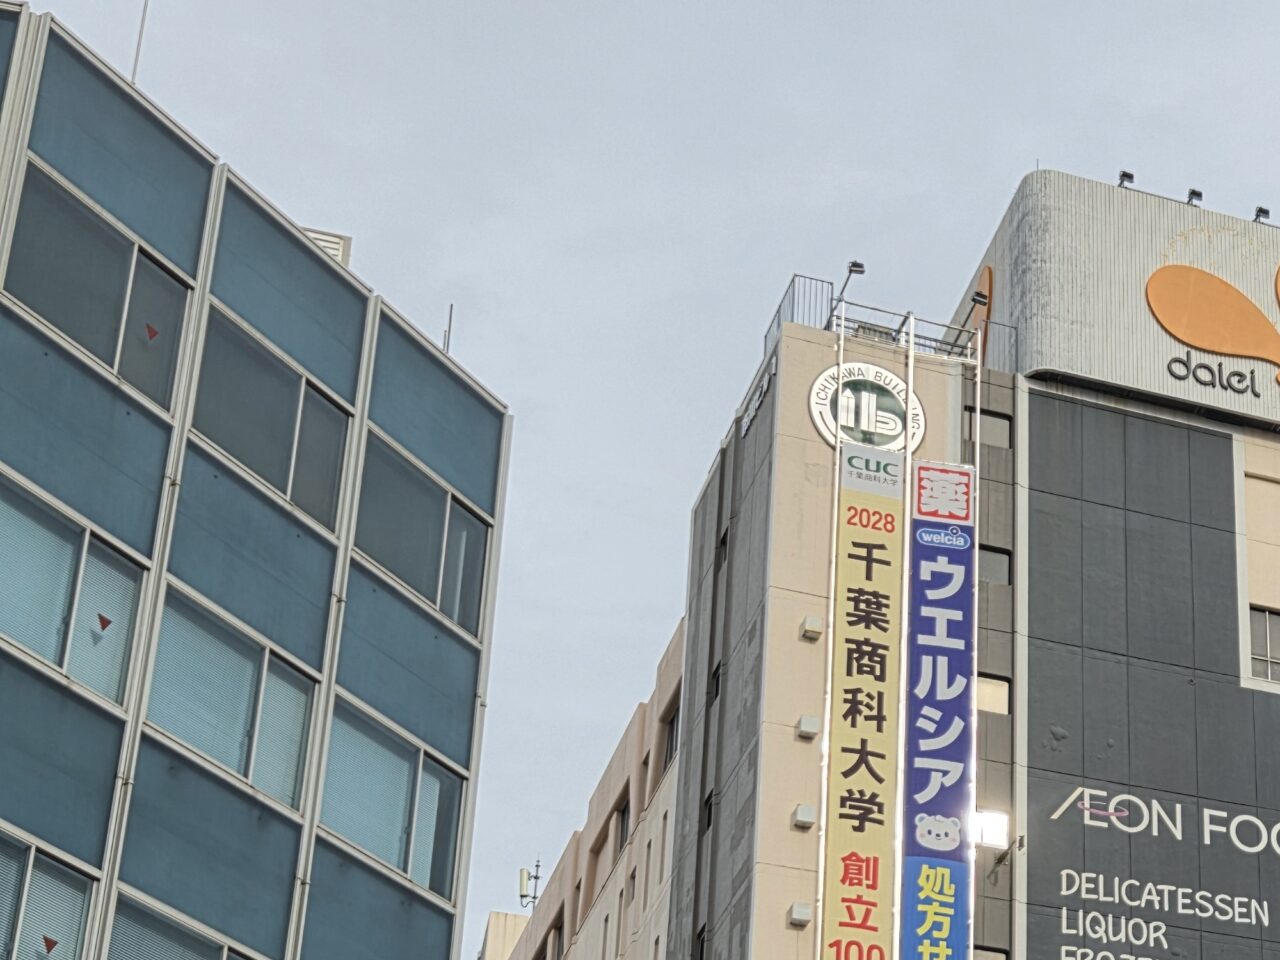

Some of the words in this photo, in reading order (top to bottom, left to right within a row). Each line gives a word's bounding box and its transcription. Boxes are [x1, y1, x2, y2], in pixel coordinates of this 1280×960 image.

[1167, 350, 1261, 398] daiei
[847, 455, 899, 478] CUC
[846, 506, 896, 533] 2028
[921, 529, 966, 547] welcia
[839, 541, 892, 833] 千葉商科大学
[913, 555, 968, 804] ウエルシア
[1060, 869, 1270, 927] DELICATESSEN
[1060, 907, 1169, 950] LIQUOR
